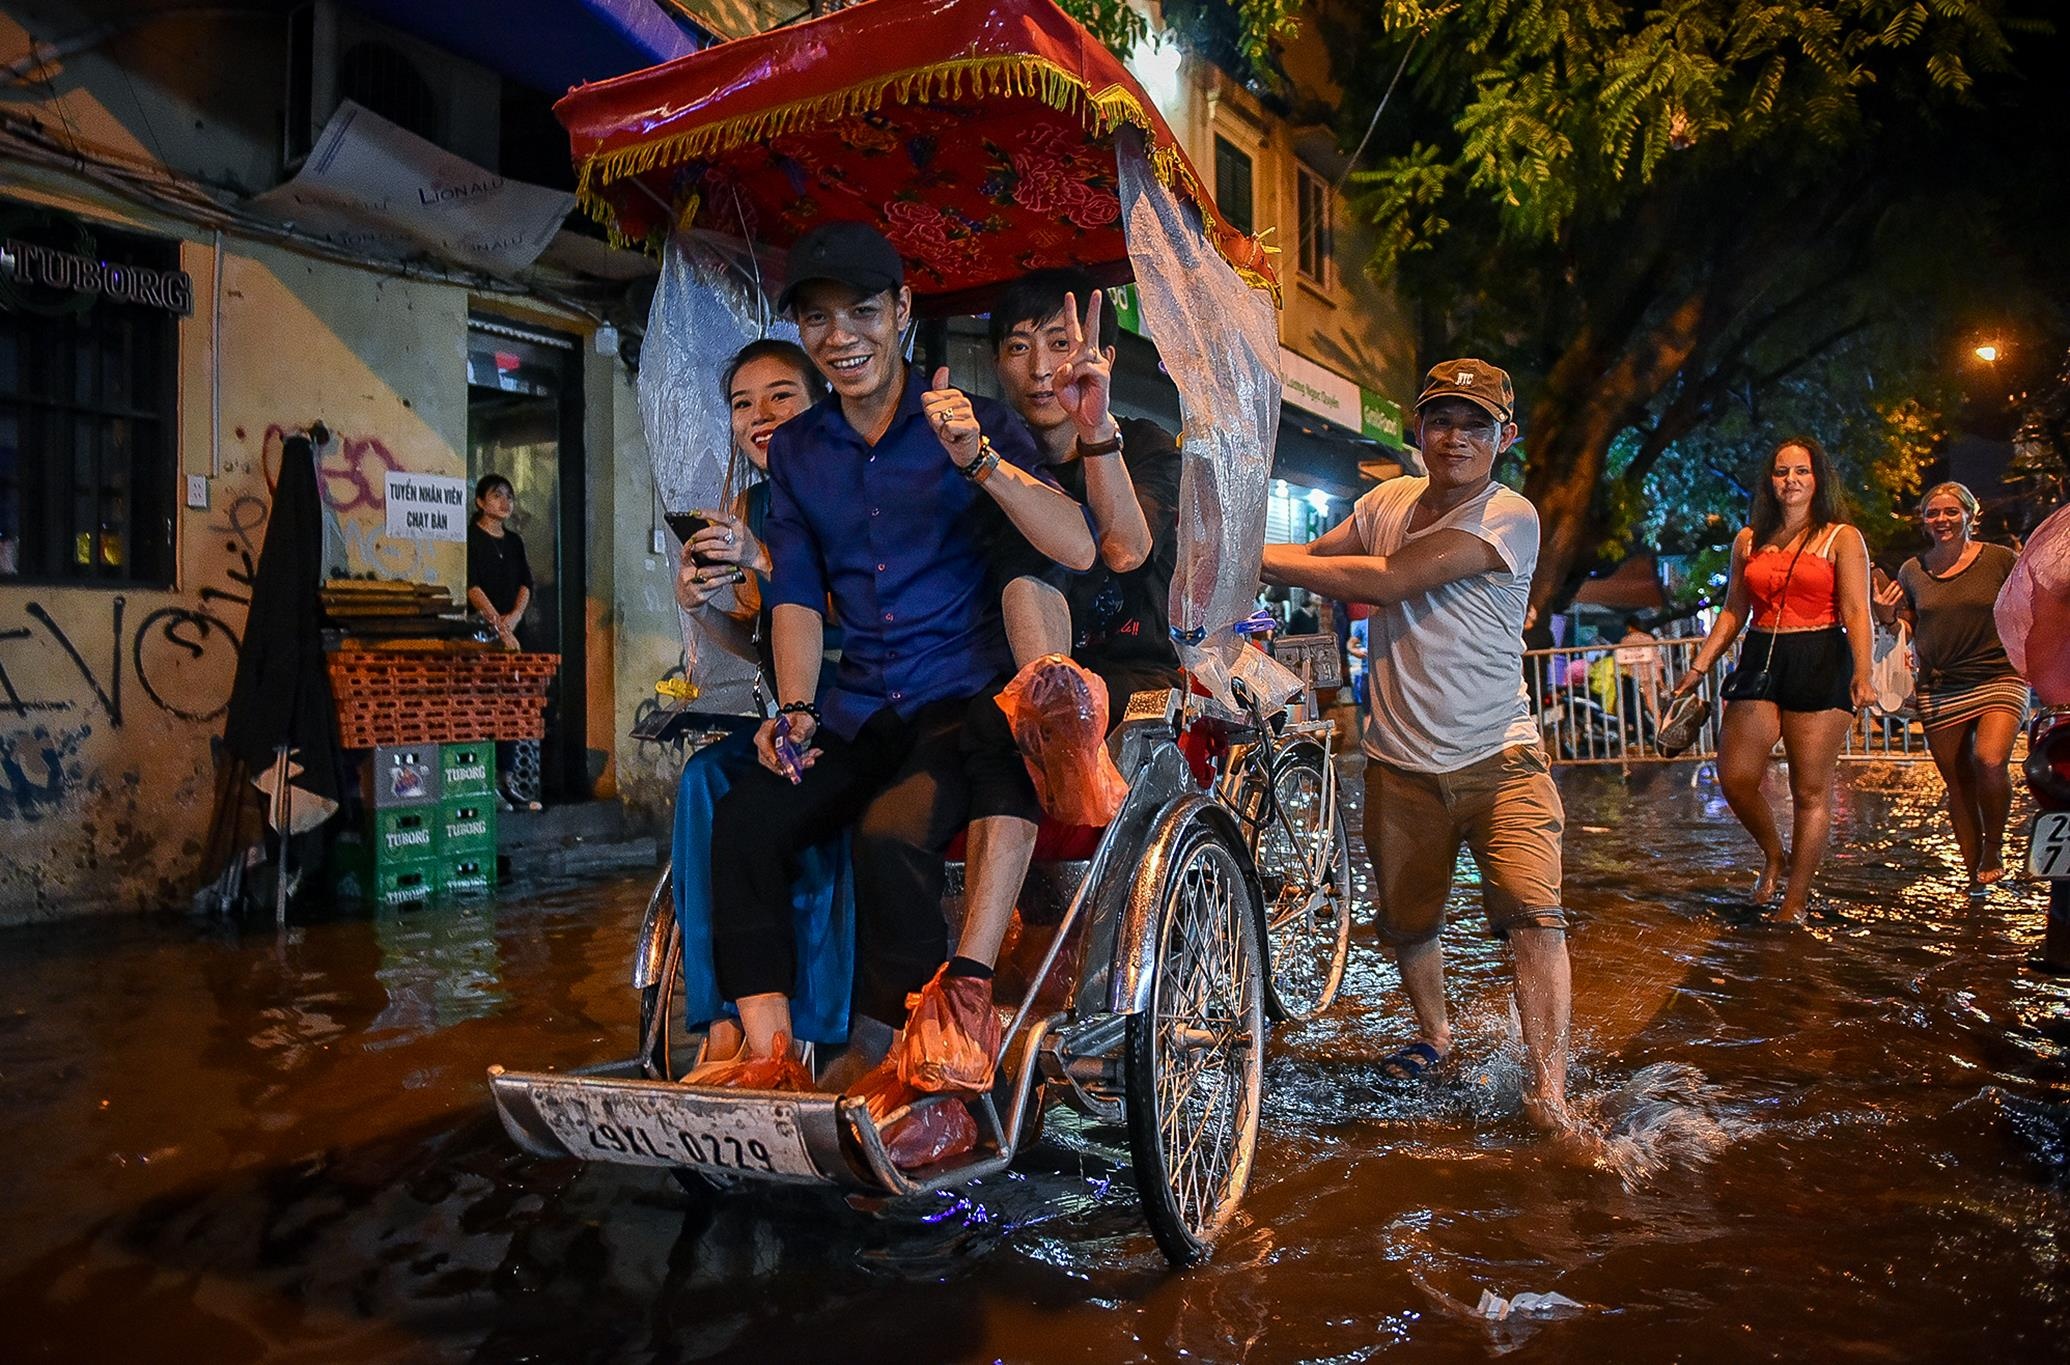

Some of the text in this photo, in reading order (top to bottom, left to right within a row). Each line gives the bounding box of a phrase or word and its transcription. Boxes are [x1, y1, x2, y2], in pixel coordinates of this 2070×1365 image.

[6, 238, 194, 320] TUBORG
[389, 478, 463, 506] TUYỂN NHÂN VIÊN
[406, 509, 448, 532] CHẠY BÀN
[445, 765, 486, 783] TUBORG
[385, 829, 430, 848] TUBORG
[446, 820, 487, 838] TUBORG
[2047, 814, 2070, 843] 2
[2041, 845, 2070, 875] 7
[586, 1121, 778, 1173] 29XL-0229
